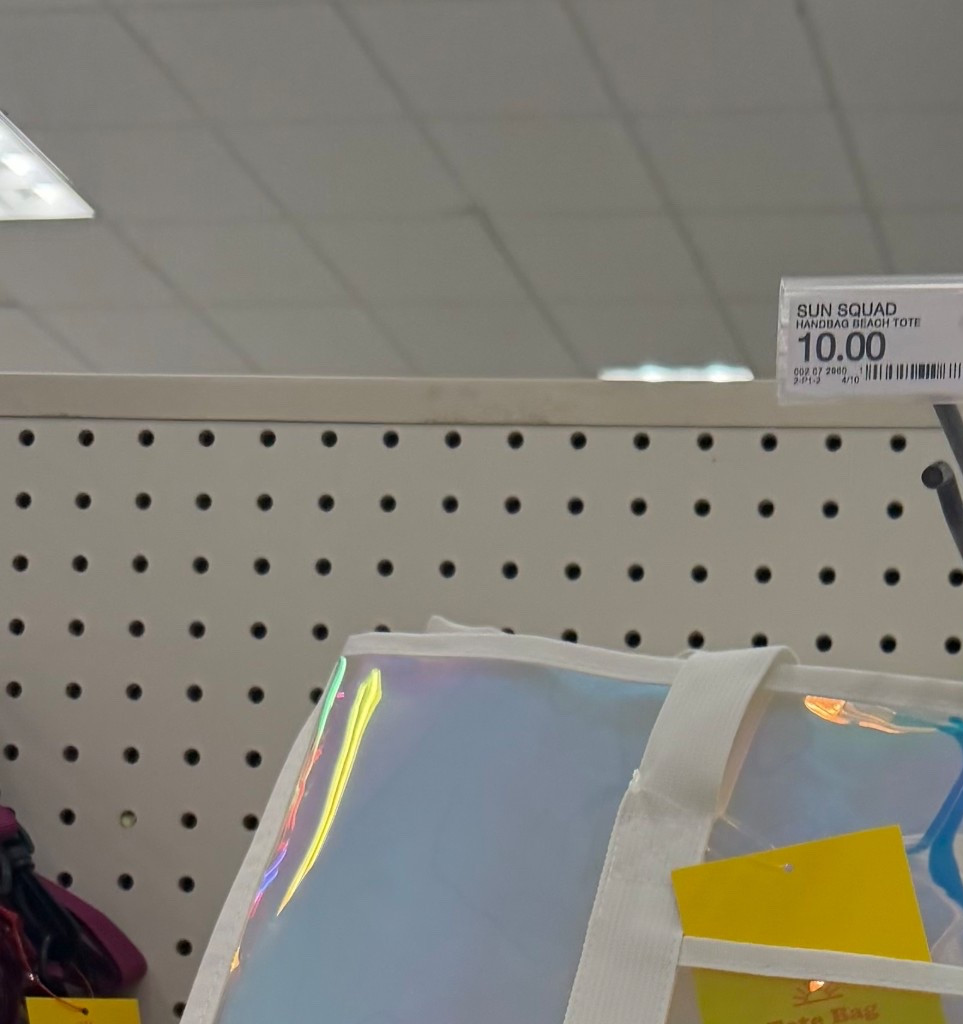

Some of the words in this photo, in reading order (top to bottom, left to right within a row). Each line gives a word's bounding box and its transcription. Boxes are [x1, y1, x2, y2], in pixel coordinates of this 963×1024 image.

[797, 303, 832, 318] SUN
[837, 302, 897, 317] SQUAD
[796, 319, 849, 329] HANDBAG
[853, 318, 889, 328] BEACH
[893, 317, 921, 327] TOTE
[797, 331, 886, 363] 10.00
[830, 1003, 880, 1024] Bag
